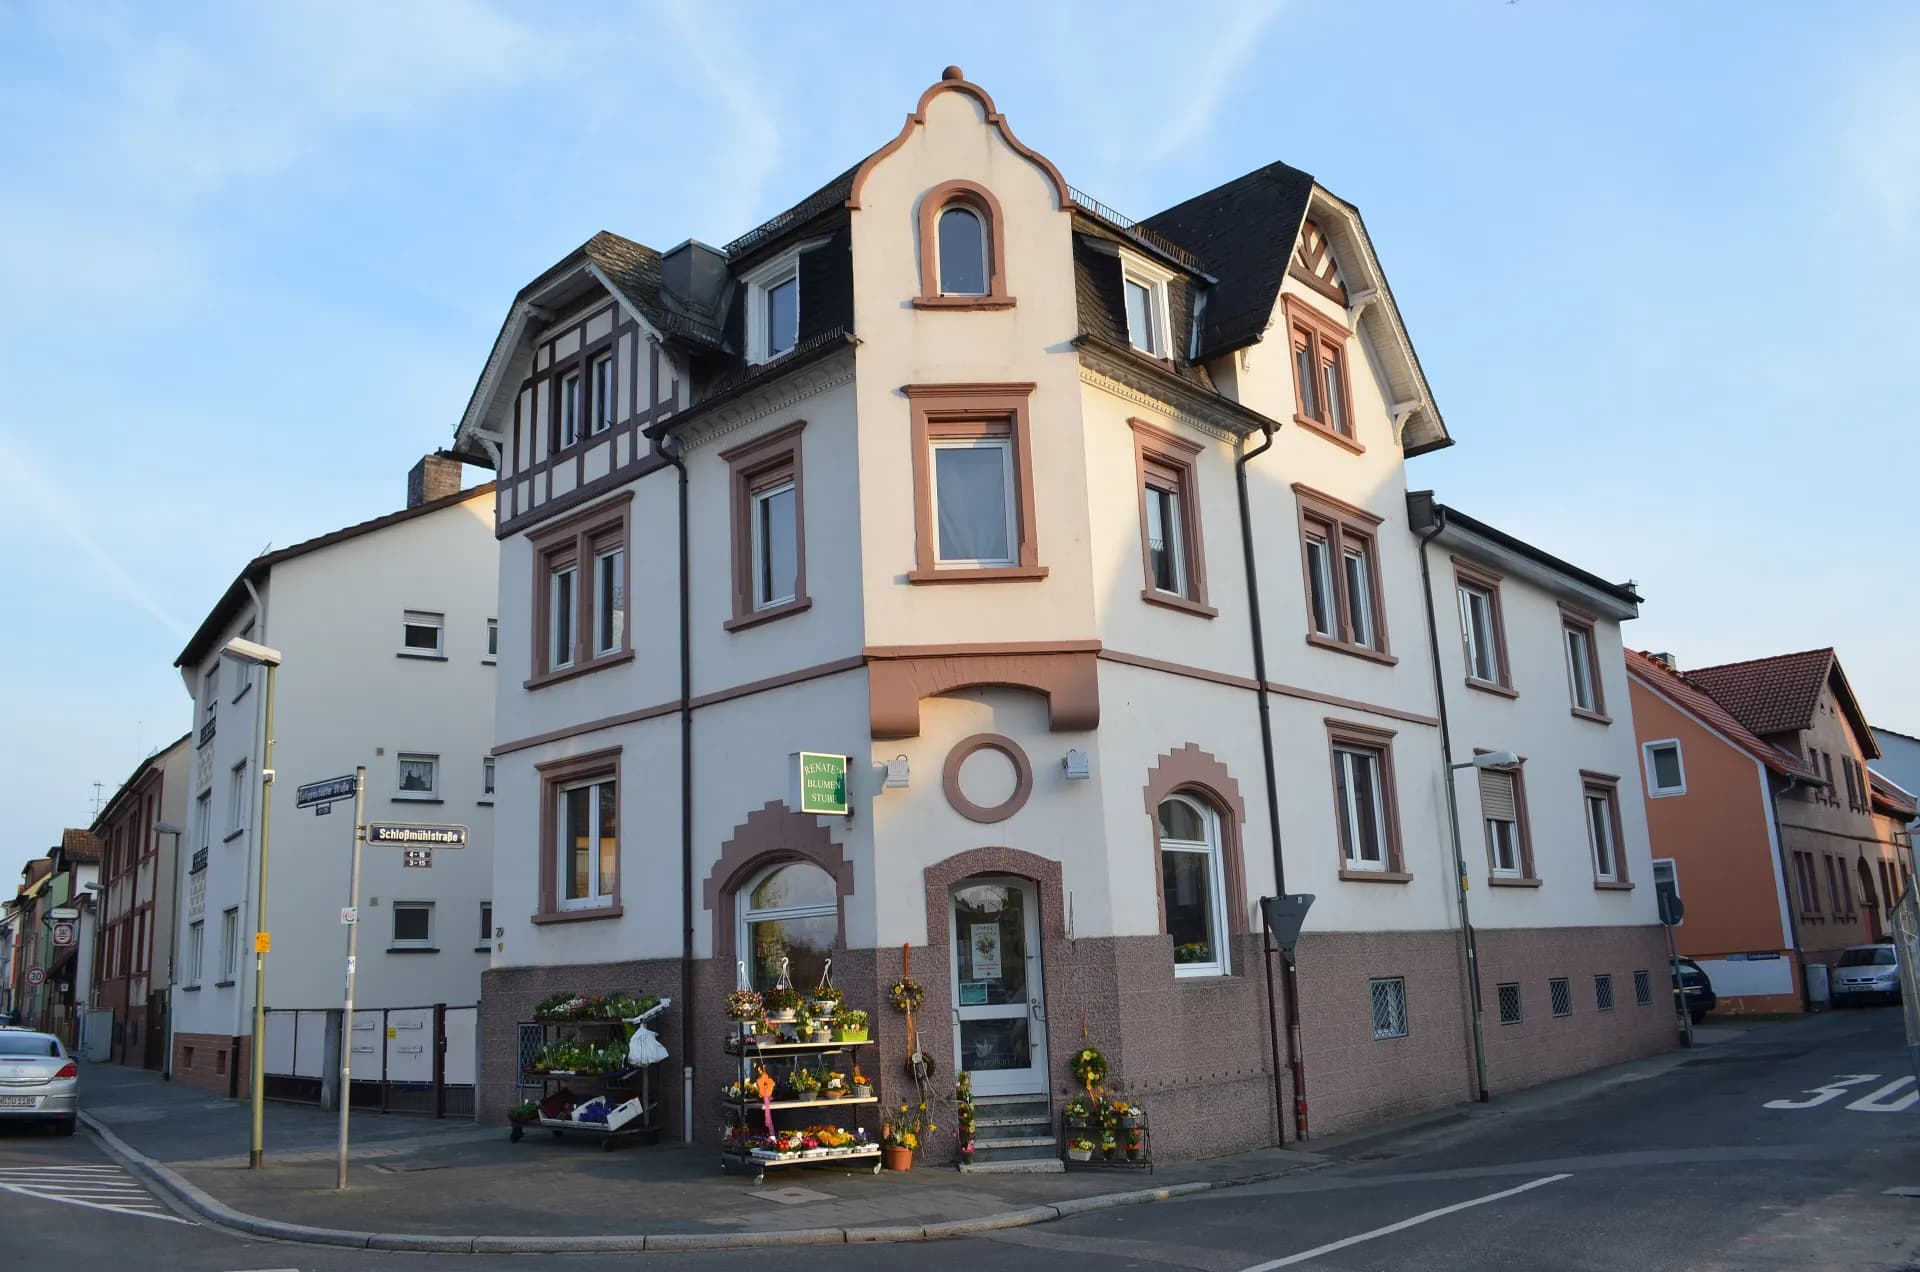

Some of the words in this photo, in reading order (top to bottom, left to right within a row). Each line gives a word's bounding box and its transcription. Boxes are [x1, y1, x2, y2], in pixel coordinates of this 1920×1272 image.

[807, 779, 841, 789] BLUMEN
[380, 829, 457, 843] Schloßmühlstraße
[31, 973, 42, 981] 30
